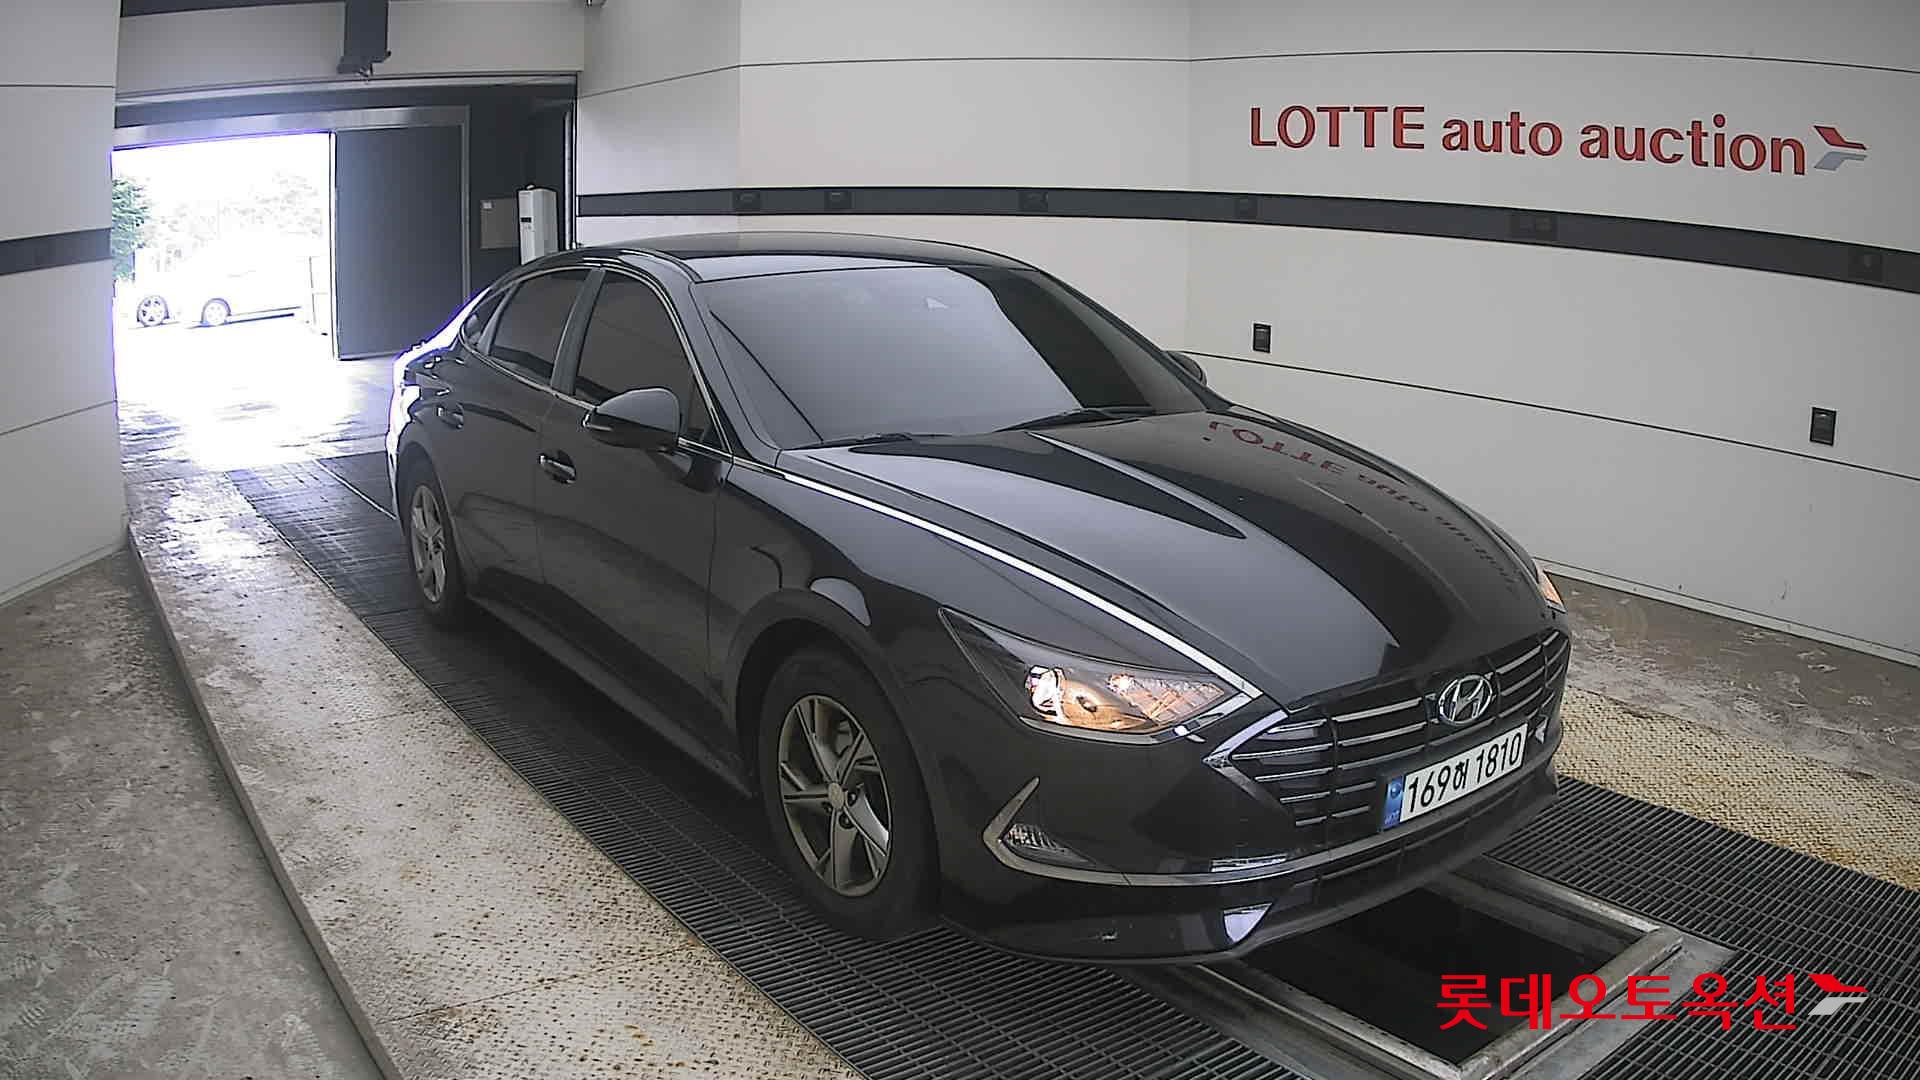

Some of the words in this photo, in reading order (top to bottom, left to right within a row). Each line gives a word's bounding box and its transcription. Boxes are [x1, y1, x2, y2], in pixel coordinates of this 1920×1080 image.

[1251, 106, 1425, 149] LOTTE
[1443, 112, 1563, 156] auto
[1580, 115, 1806, 175] auction
[1408, 758, 1470, 813] 169허
[1476, 732, 1522, 784] 1810
